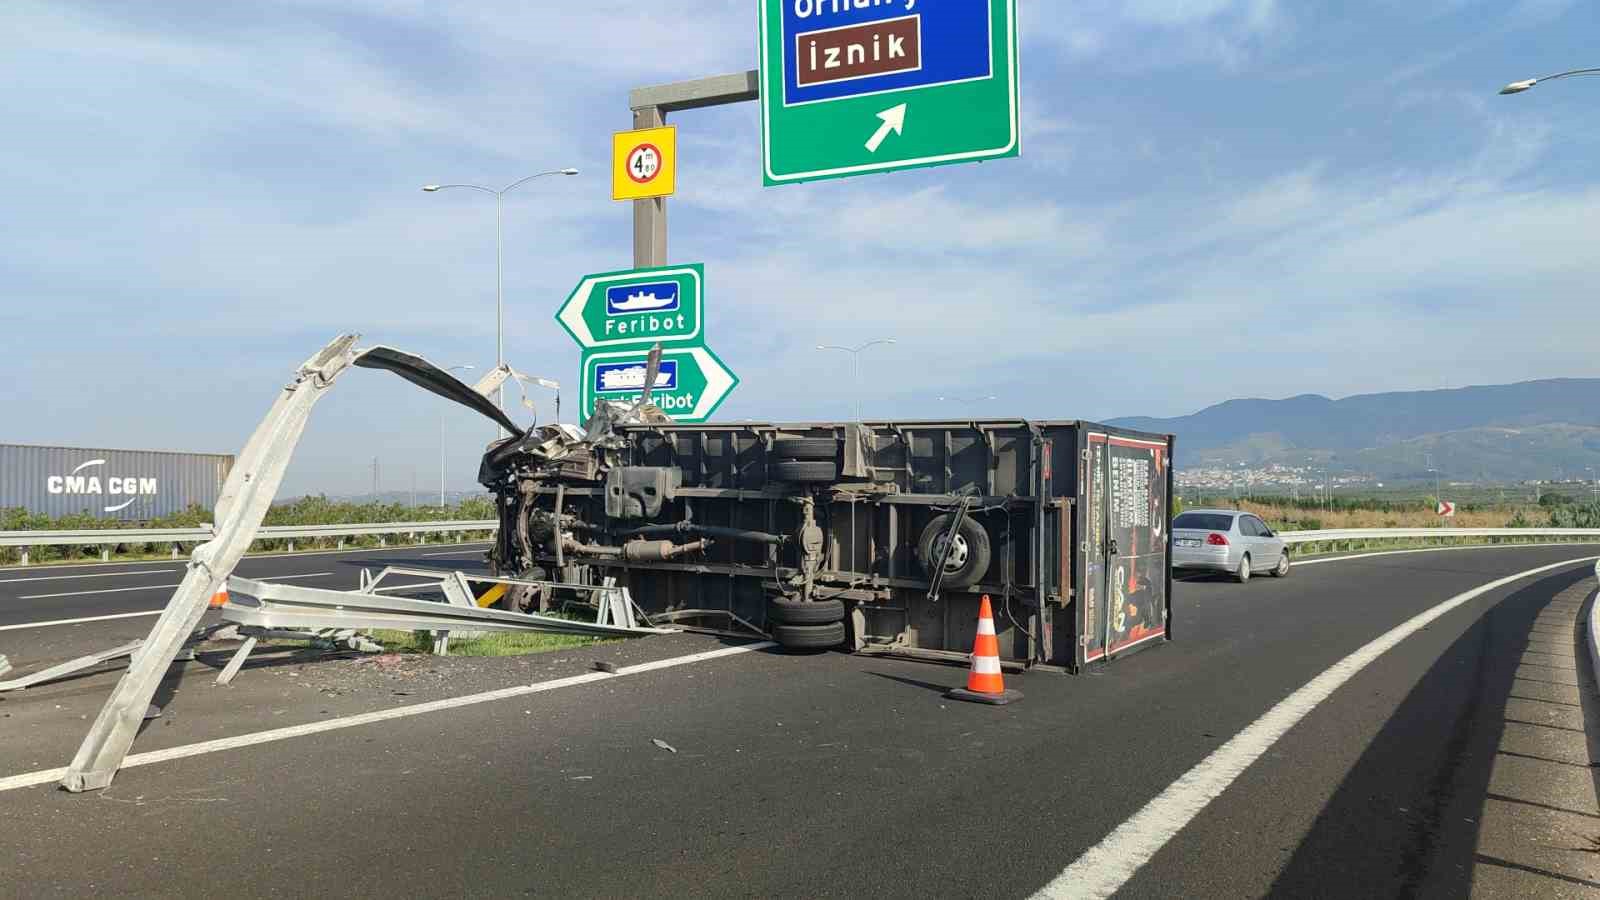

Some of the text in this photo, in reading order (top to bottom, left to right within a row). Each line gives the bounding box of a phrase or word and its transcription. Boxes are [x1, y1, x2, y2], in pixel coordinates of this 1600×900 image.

[810, 34, 906, 71] İznik
[606, 314, 685, 335] Feribot
[48, 475, 157, 495] CMA CGM
